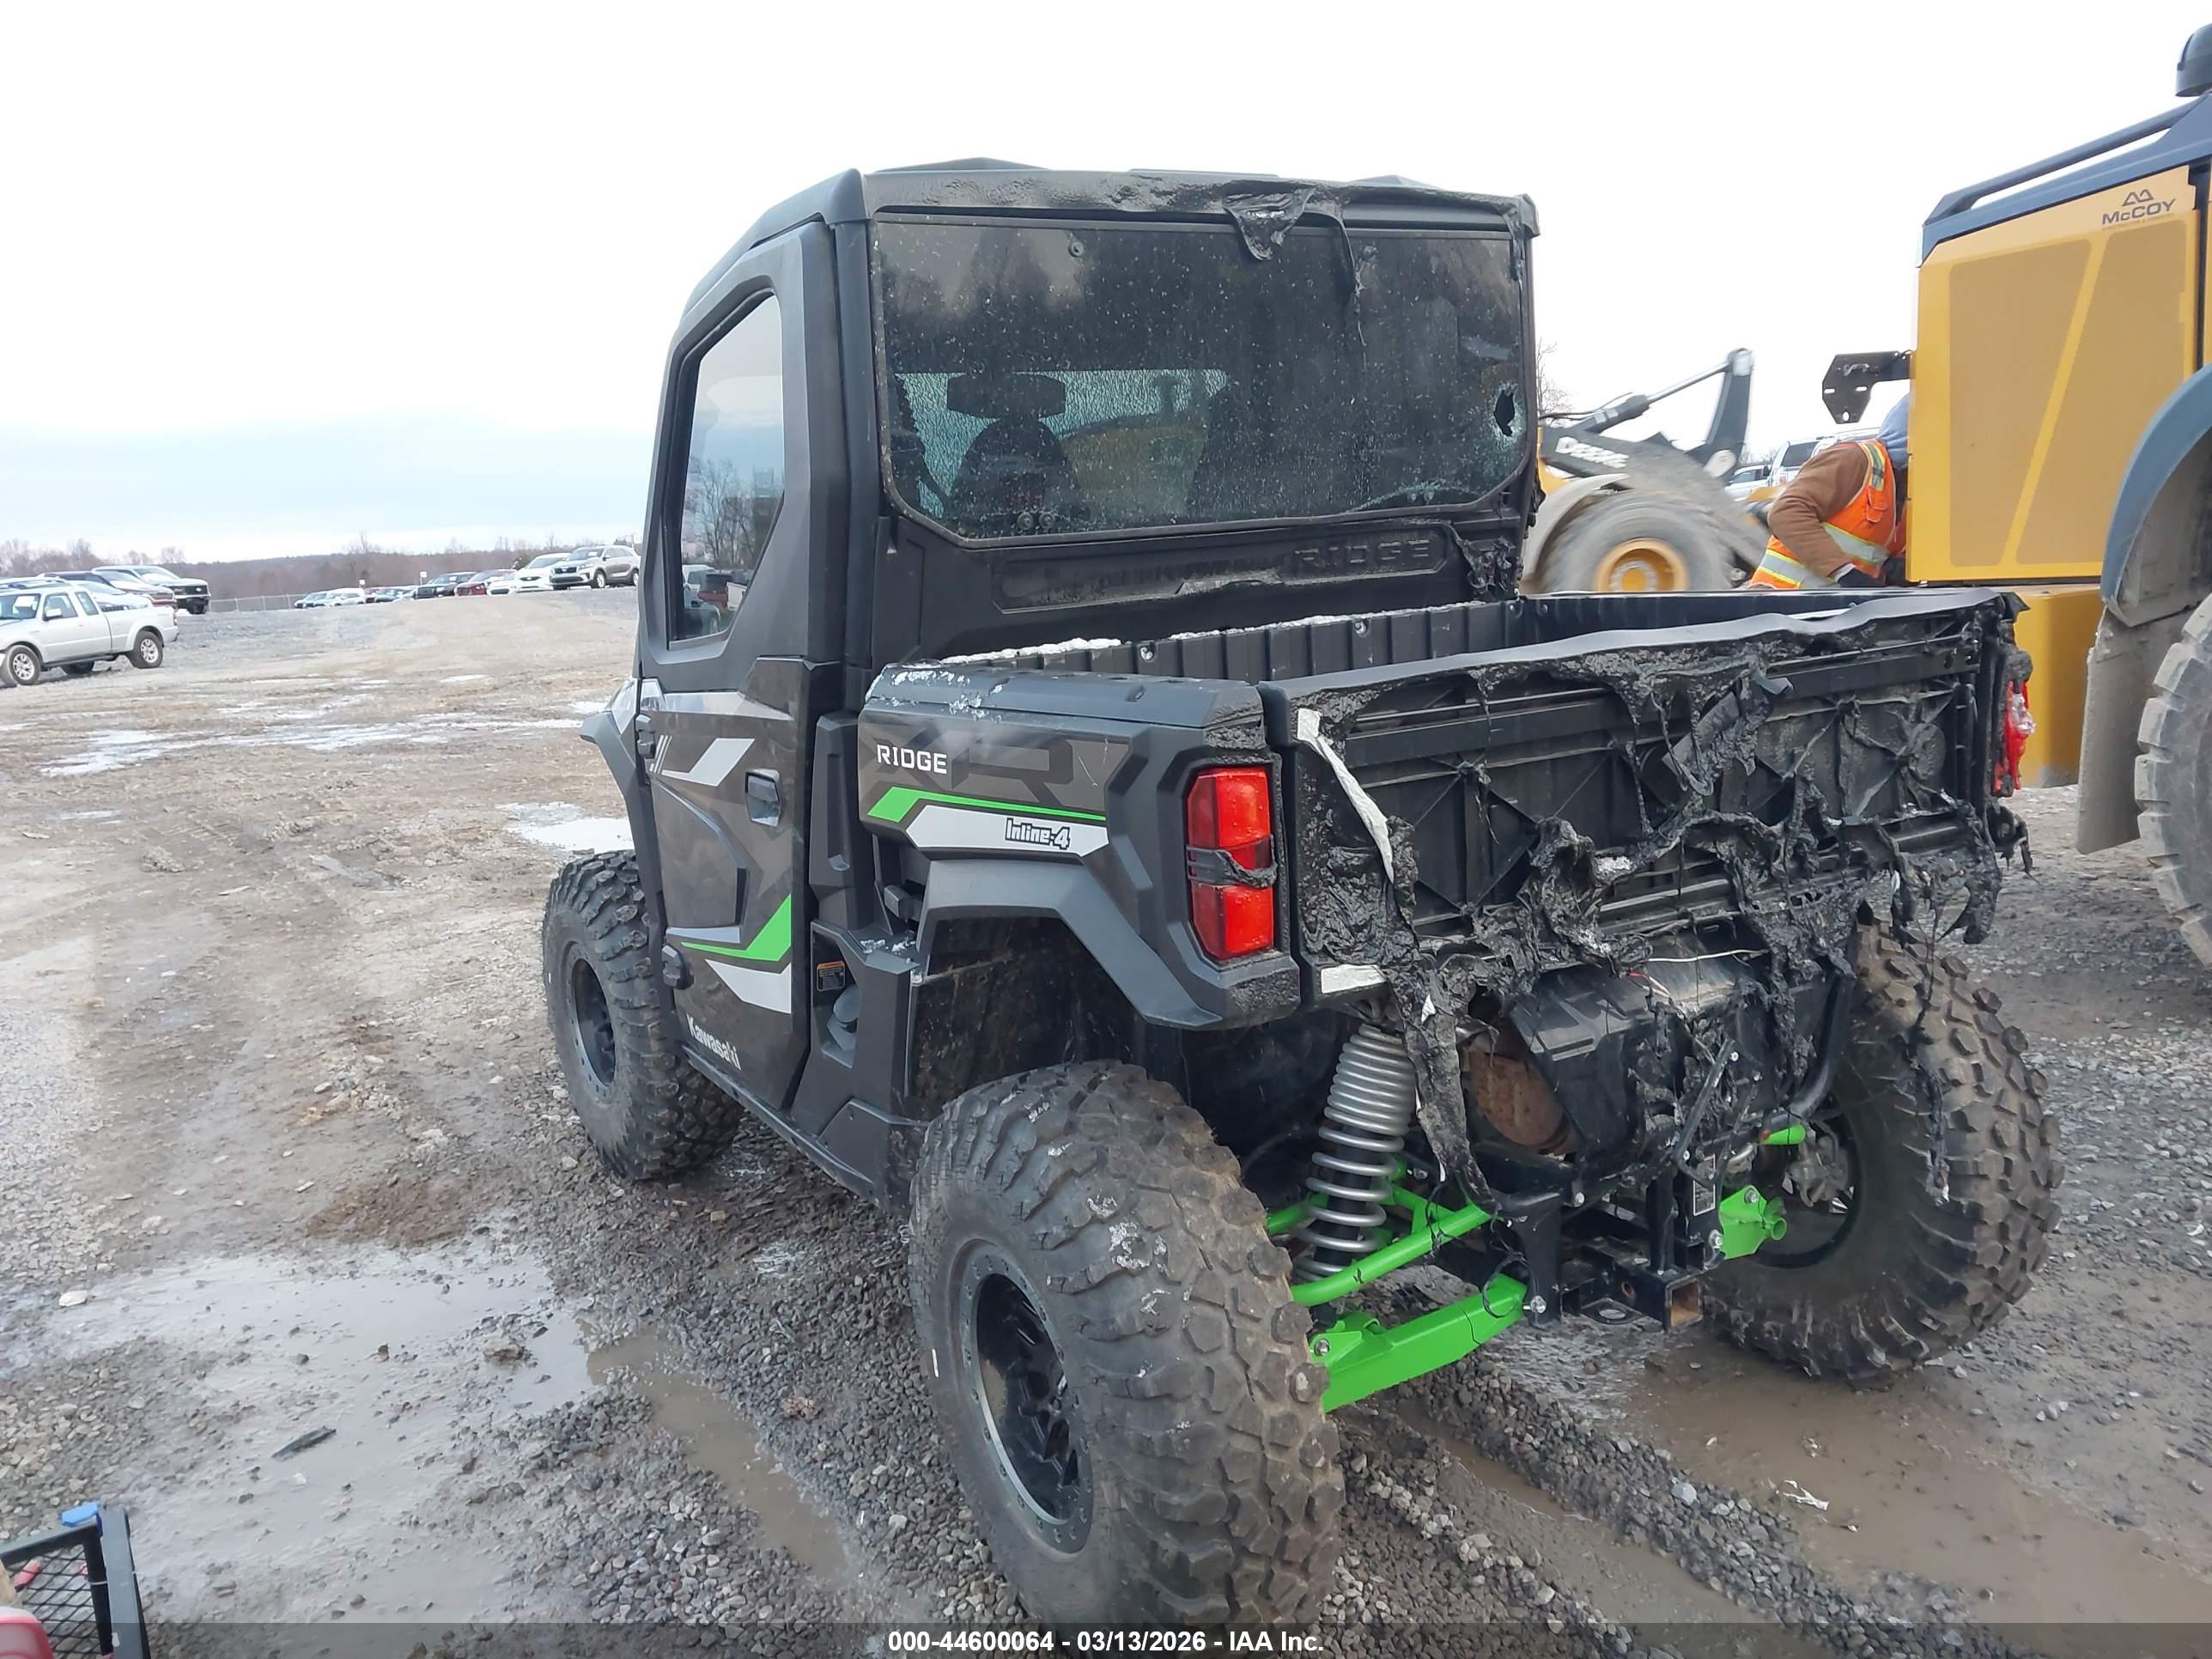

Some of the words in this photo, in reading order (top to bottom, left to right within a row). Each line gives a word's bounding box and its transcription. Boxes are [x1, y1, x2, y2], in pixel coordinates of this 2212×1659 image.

[2102, 198, 2176, 225] McCOY
[876, 744, 948, 775] RIDGE
[1006, 817, 1071, 849] Inline-4
[686, 1014, 741, 1070] Kawasaki
